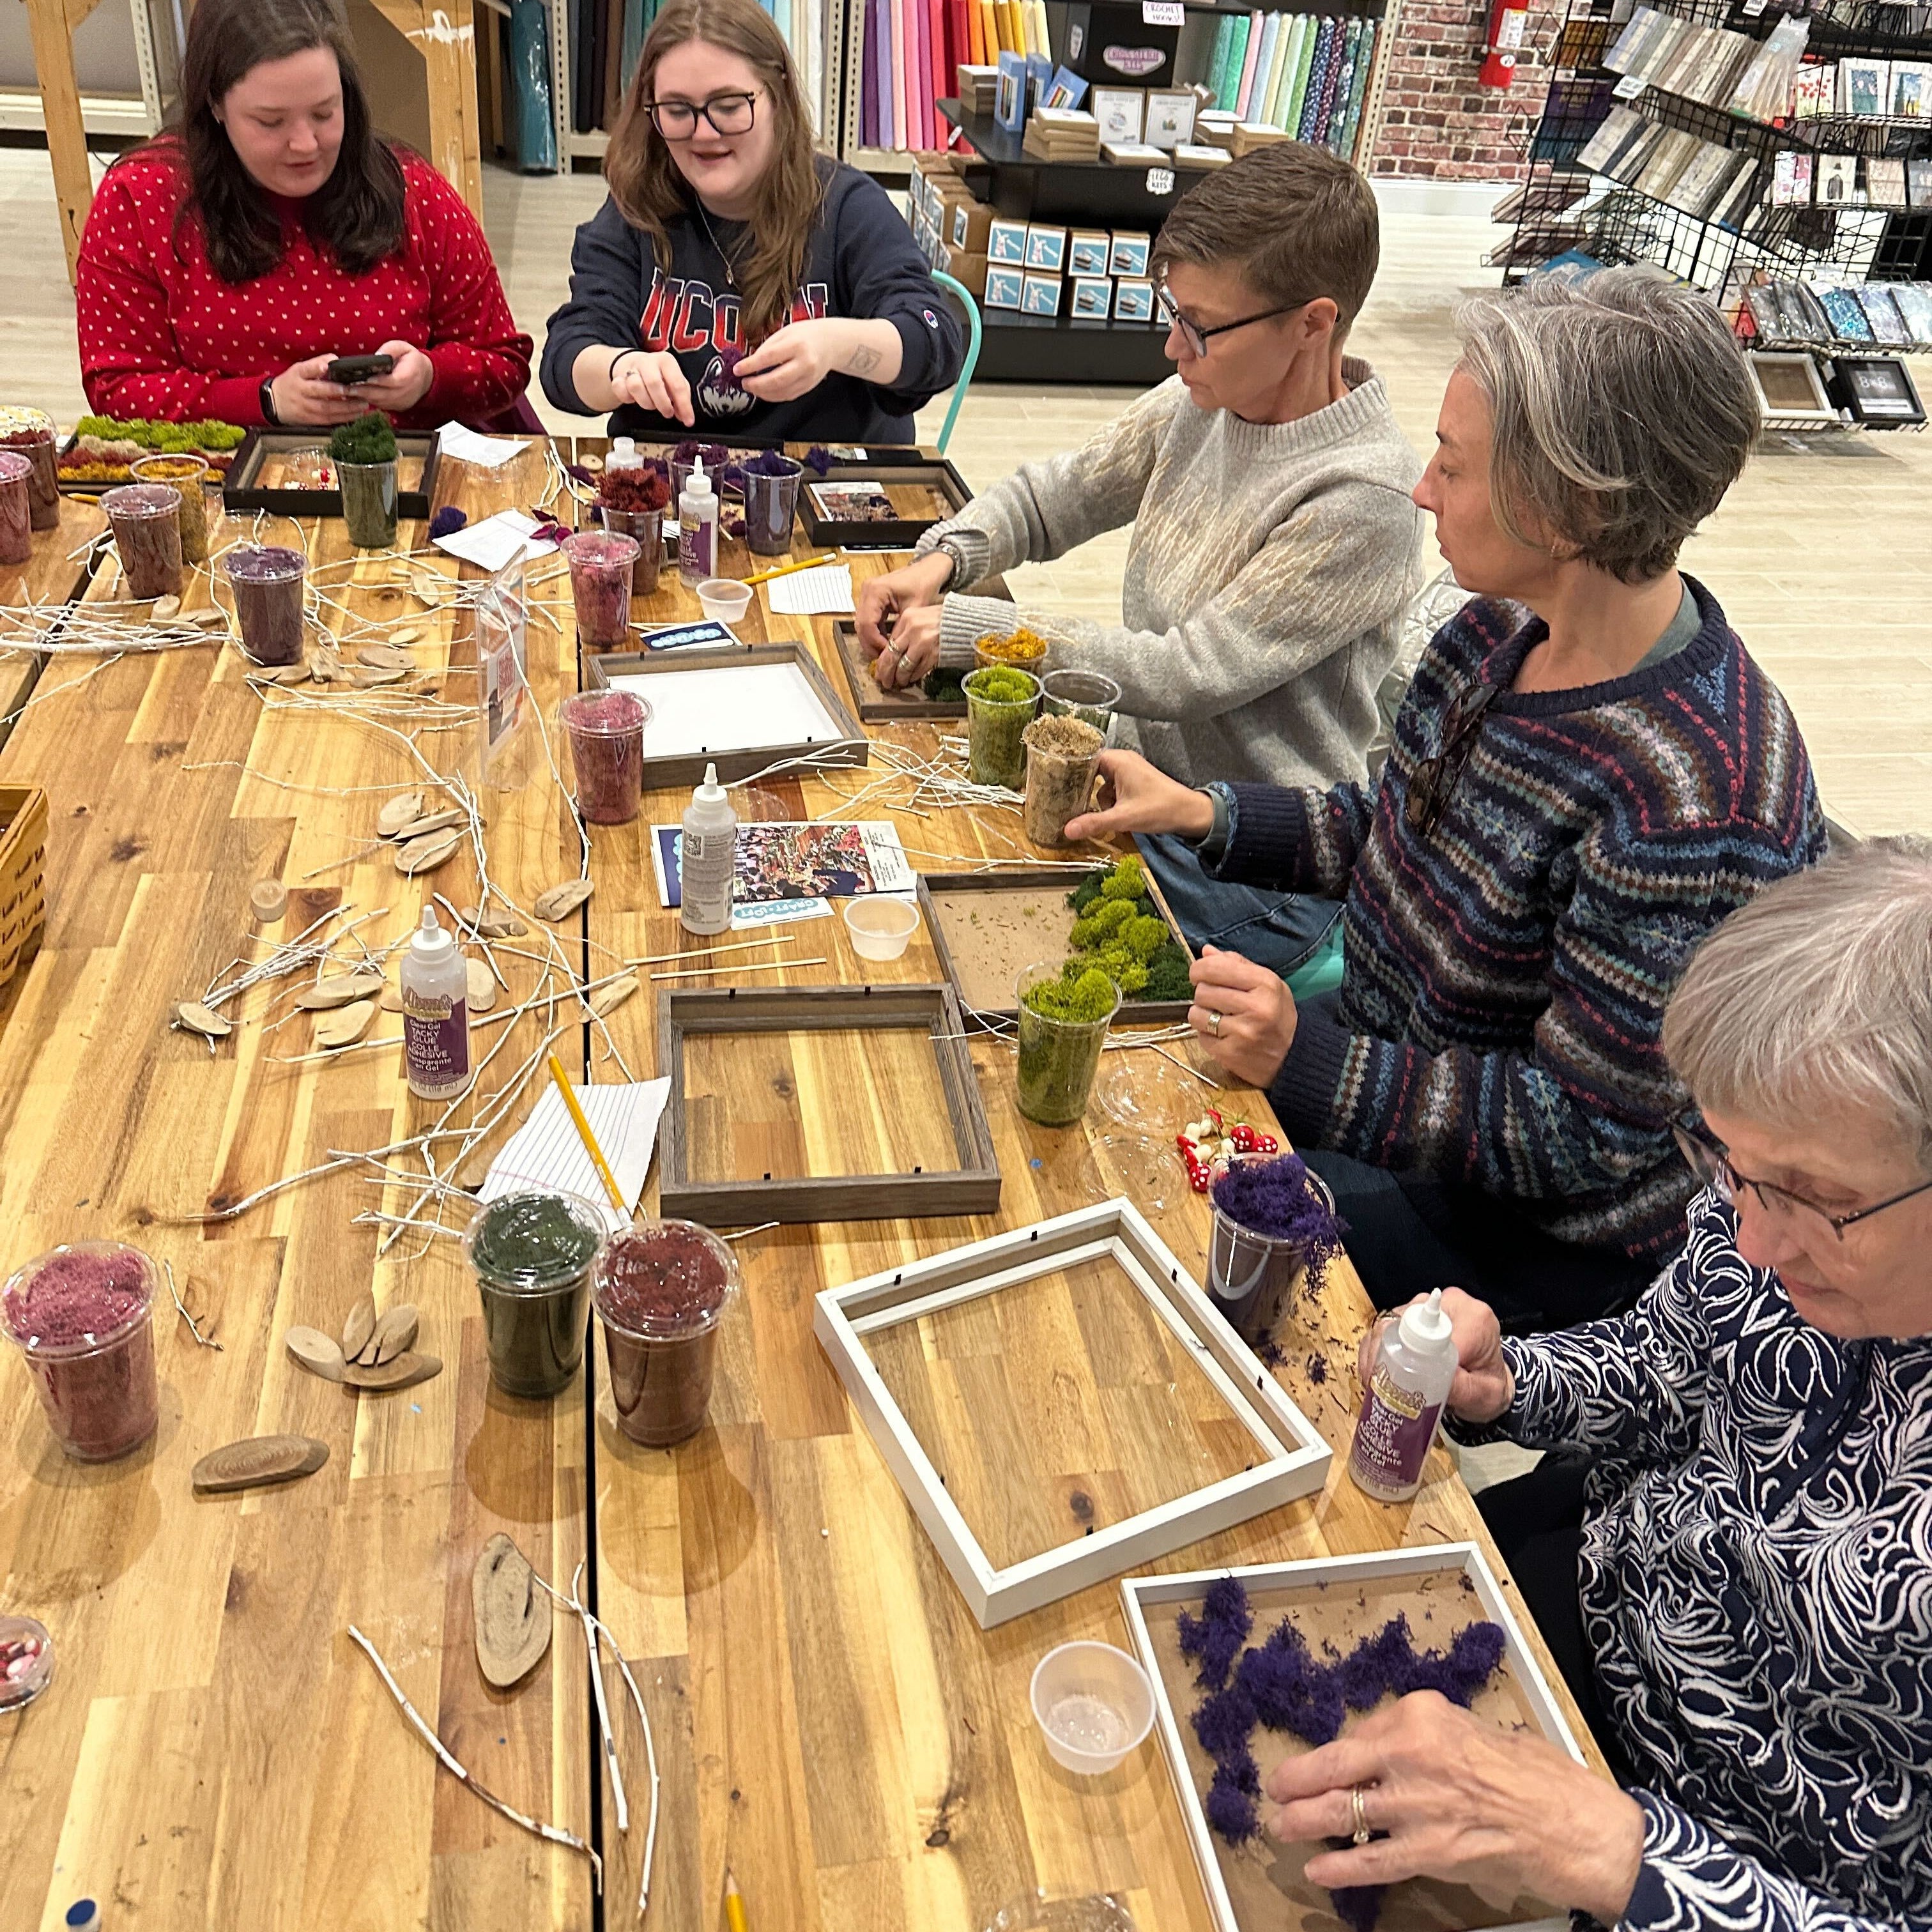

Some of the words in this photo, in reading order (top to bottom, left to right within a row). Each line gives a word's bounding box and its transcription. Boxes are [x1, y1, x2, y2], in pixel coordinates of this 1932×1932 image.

[640, 266, 829, 356] UCON
[411, 1027, 440, 1039] TACKY
[413, 1035, 436, 1045] GLUE
[408, 1046, 448, 1059] ADHESIVE
[412, 1042, 440, 1052] COLLE
